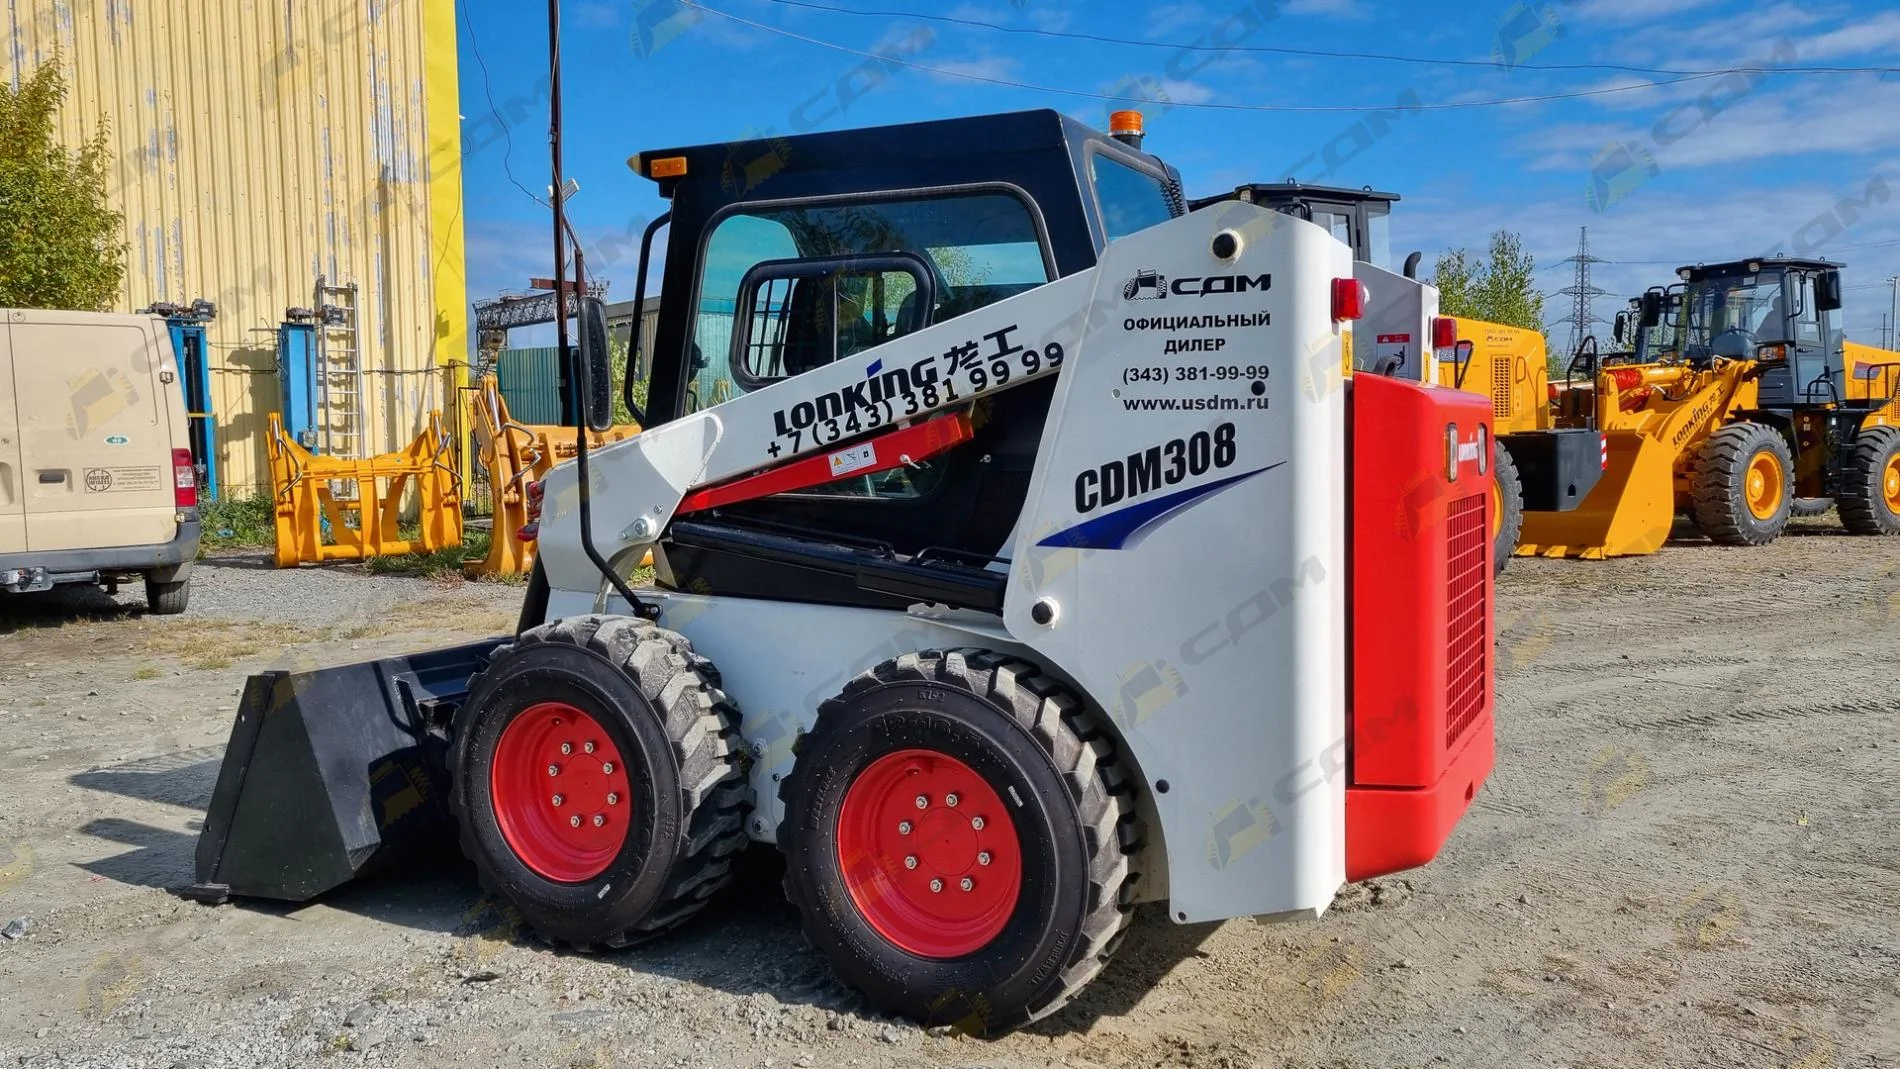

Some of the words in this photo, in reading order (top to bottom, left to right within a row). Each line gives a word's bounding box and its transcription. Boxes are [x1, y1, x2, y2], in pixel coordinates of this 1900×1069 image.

[1171, 273, 1272, 298] СДМ
[1123, 310, 1271, 332] ОФИЦИАЛЬНЫЙ
[1164, 338, 1226, 355] ДИЛЕР
[1123, 367, 1169, 385] (343)
[1175, 365, 1270, 381] 381-99-99
[812, 402, 895, 446] (343)
[904, 377, 960, 415] 381
[969, 359, 1011, 392] 99
[1021, 341, 1065, 375] 99
[1123, 394, 1269, 411] www.usdm.ru
[1074, 422, 1237, 514] CDM308
